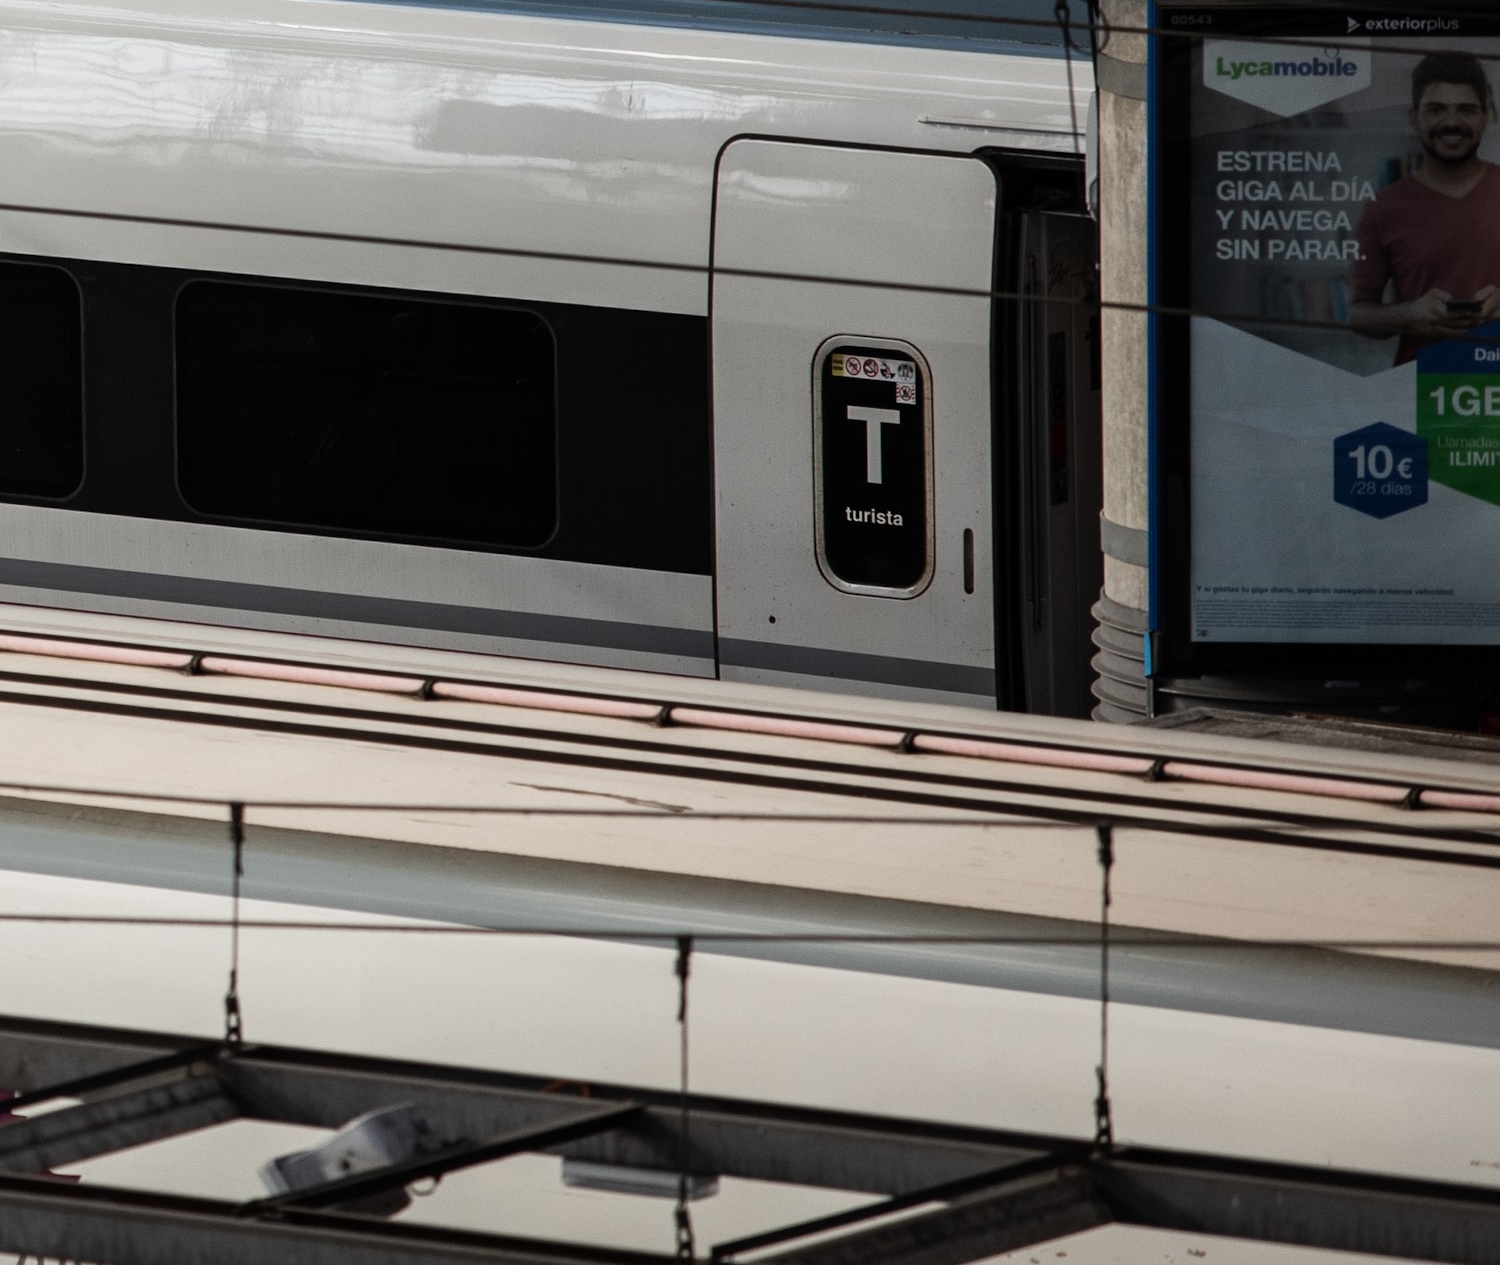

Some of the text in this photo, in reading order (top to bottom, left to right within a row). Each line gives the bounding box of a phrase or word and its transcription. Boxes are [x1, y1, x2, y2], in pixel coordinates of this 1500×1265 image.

[1365, 17, 1459, 32] exteriorplus
[1216, 56, 1358, 80] Lycamobile
[1217, 151, 1342, 172] ESTRENA
[1216, 175, 1377, 202] GIGA AL DÍA
[1216, 209, 1352, 231] Y NAVEGA
[1216, 239, 1367, 260] SIN PARAR.
[1474, 348, 1500, 362] Dai
[847, 405, 900, 484] T
[1350, 481, 1412, 495] /28 días
[845, 506, 903, 526] turista
